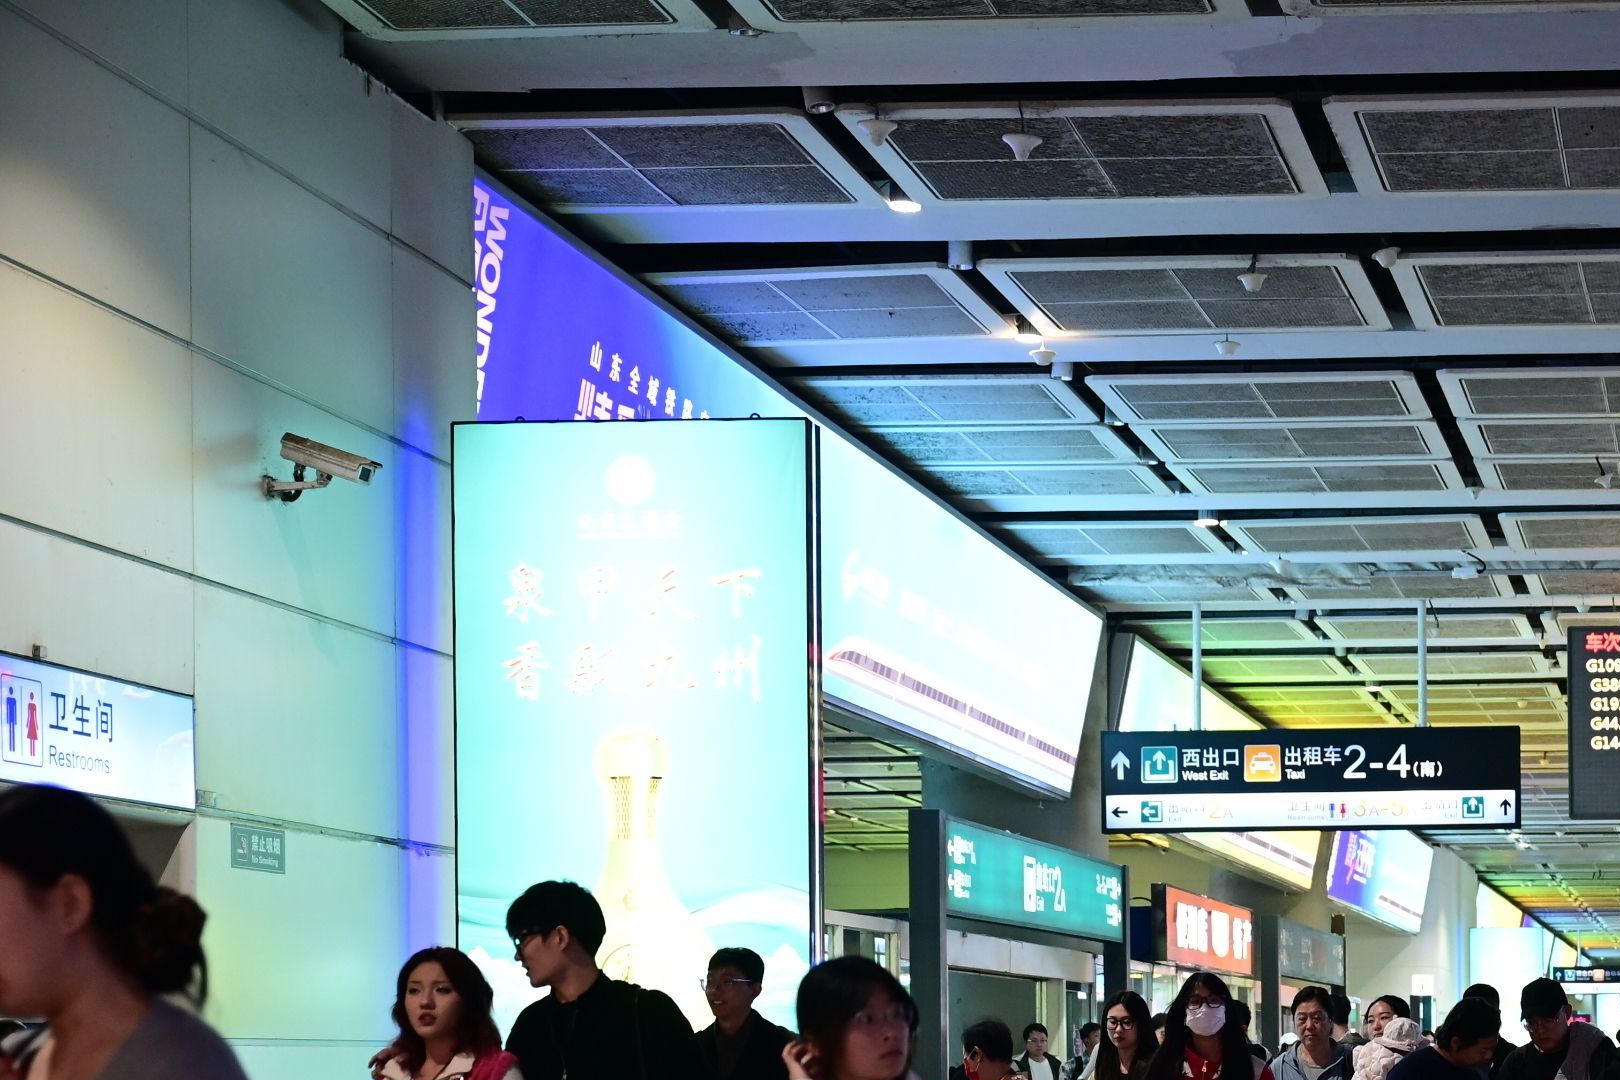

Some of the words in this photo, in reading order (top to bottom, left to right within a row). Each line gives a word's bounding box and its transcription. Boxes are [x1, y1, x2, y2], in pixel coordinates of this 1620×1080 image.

[49, 690, 114, 743] 卫生间
[49, 745, 111, 774] Restrooms
[1182, 747, 1239, 767] 西出口
[1285, 746, 1342, 766] 出租车
[1182, 770, 1208, 781] West
[1210, 770, 1229, 781] Exit
[1285, 769, 1305, 780] Taxi
